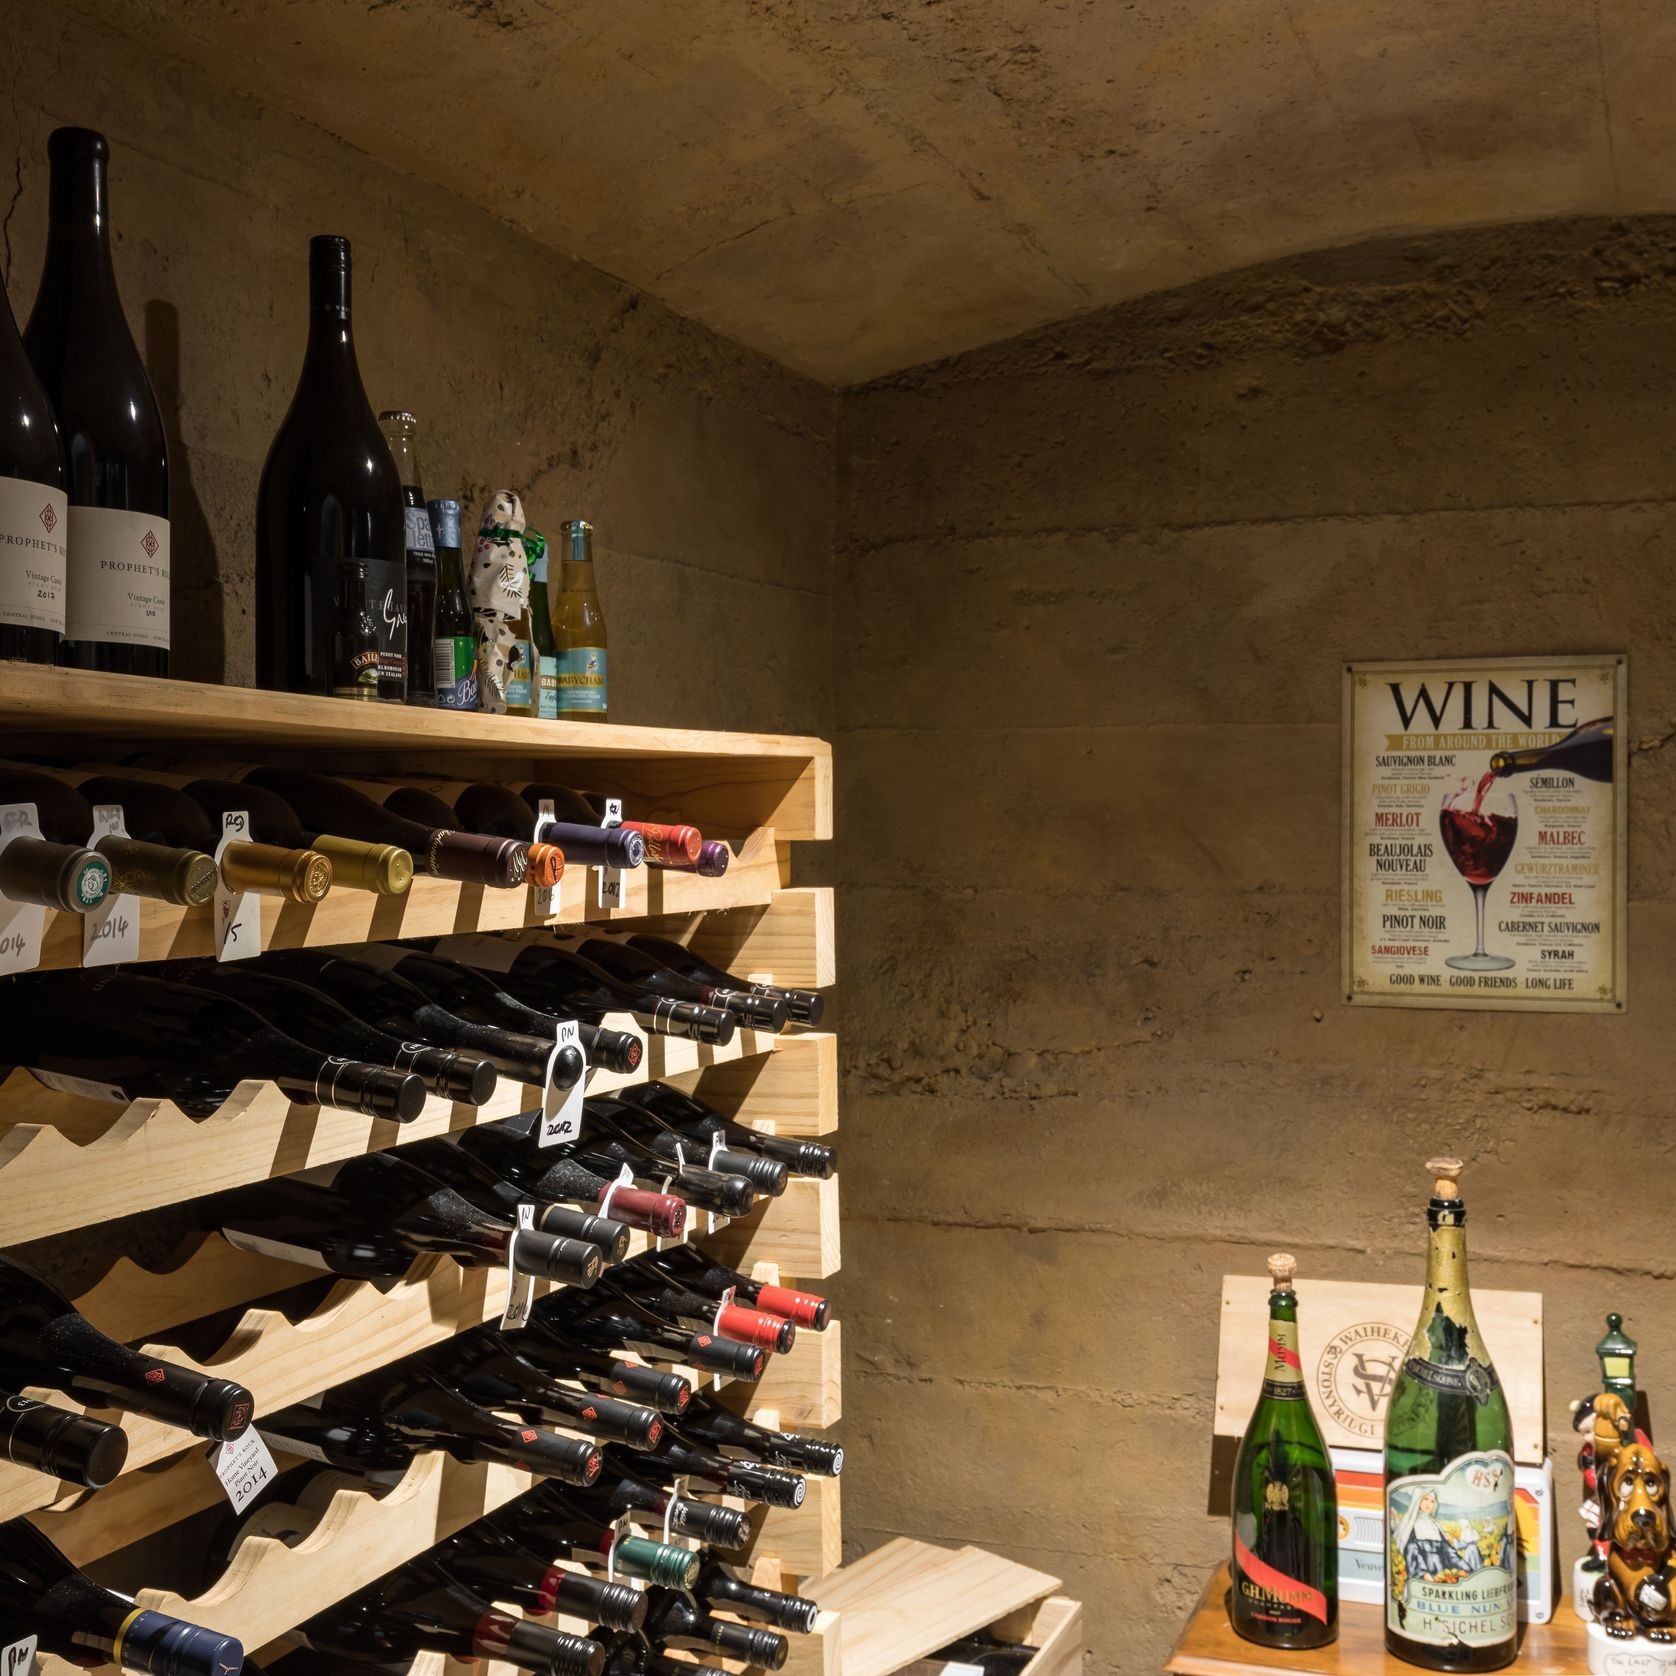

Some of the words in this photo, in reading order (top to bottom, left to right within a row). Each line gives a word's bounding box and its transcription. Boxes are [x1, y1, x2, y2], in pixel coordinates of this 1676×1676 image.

[101, 560, 160, 576] PROPHET'S
[25, 570, 50, 583] Vintage
[127, 592, 152, 604] Vintage
[1385, 678, 1578, 732] WINE
[1402, 735, 1435, 749] FROM
[1438, 735, 1486, 749] AROUND
[1491, 734, 1513, 748] THE
[1519, 734, 1560, 748] WORLD
[1375, 755, 1425, 767] SAUVIGNON
[1427, 755, 1456, 767] BLANC
[1372, 783, 1398, 795] PINOT
[1401, 784, 1430, 795] GRIGIO
[1529, 774, 1575, 789] SÉMILLON
[1375, 812, 1422, 827] MERLOT
[1538, 830, 1586, 846] MALBEC
[1369, 843, 1433, 857] BEAUJOLAIS
[1375, 858, 1427, 872] NOUVEAU
[1385, 889, 1443, 903] RIESLING
[1510, 892, 1575, 905] ZINFANDEL
[90, 915, 129, 941] 2014
[1382, 914, 1416, 929] PINOT
[1419, 915, 1446, 930] NOIR
[1498, 920, 1545, 933] CABERNET
[1547, 922, 1601, 934] SAUVIGNON
[1371, 945, 1430, 956] SANGIOVESE
[1540, 949, 1574, 960] SYRAH
[1389, 973, 1415, 986] GOOD
[1418, 974, 1442, 987] WINE
[1449, 975, 1476, 988] GOOD
[1478, 975, 1518, 989] FRIENDS
[1525, 977, 1551, 990] LONG
[1554, 978, 1574, 991] LIFE
[224, 1469, 240, 1487] Home
[238, 1446, 260, 1470] Vineyard
[234, 1471, 248, 1487] Pinot
[248, 1460, 259, 1473] Noir
[235, 1466, 268, 1503] 2014
[1422, 1586, 1478, 1601] SPARKLING
[1416, 1600, 1460, 1614] BLUE
[1471, 1602, 1501, 1615] NUN
[1442, 1618, 1496, 1635] SICHEL
